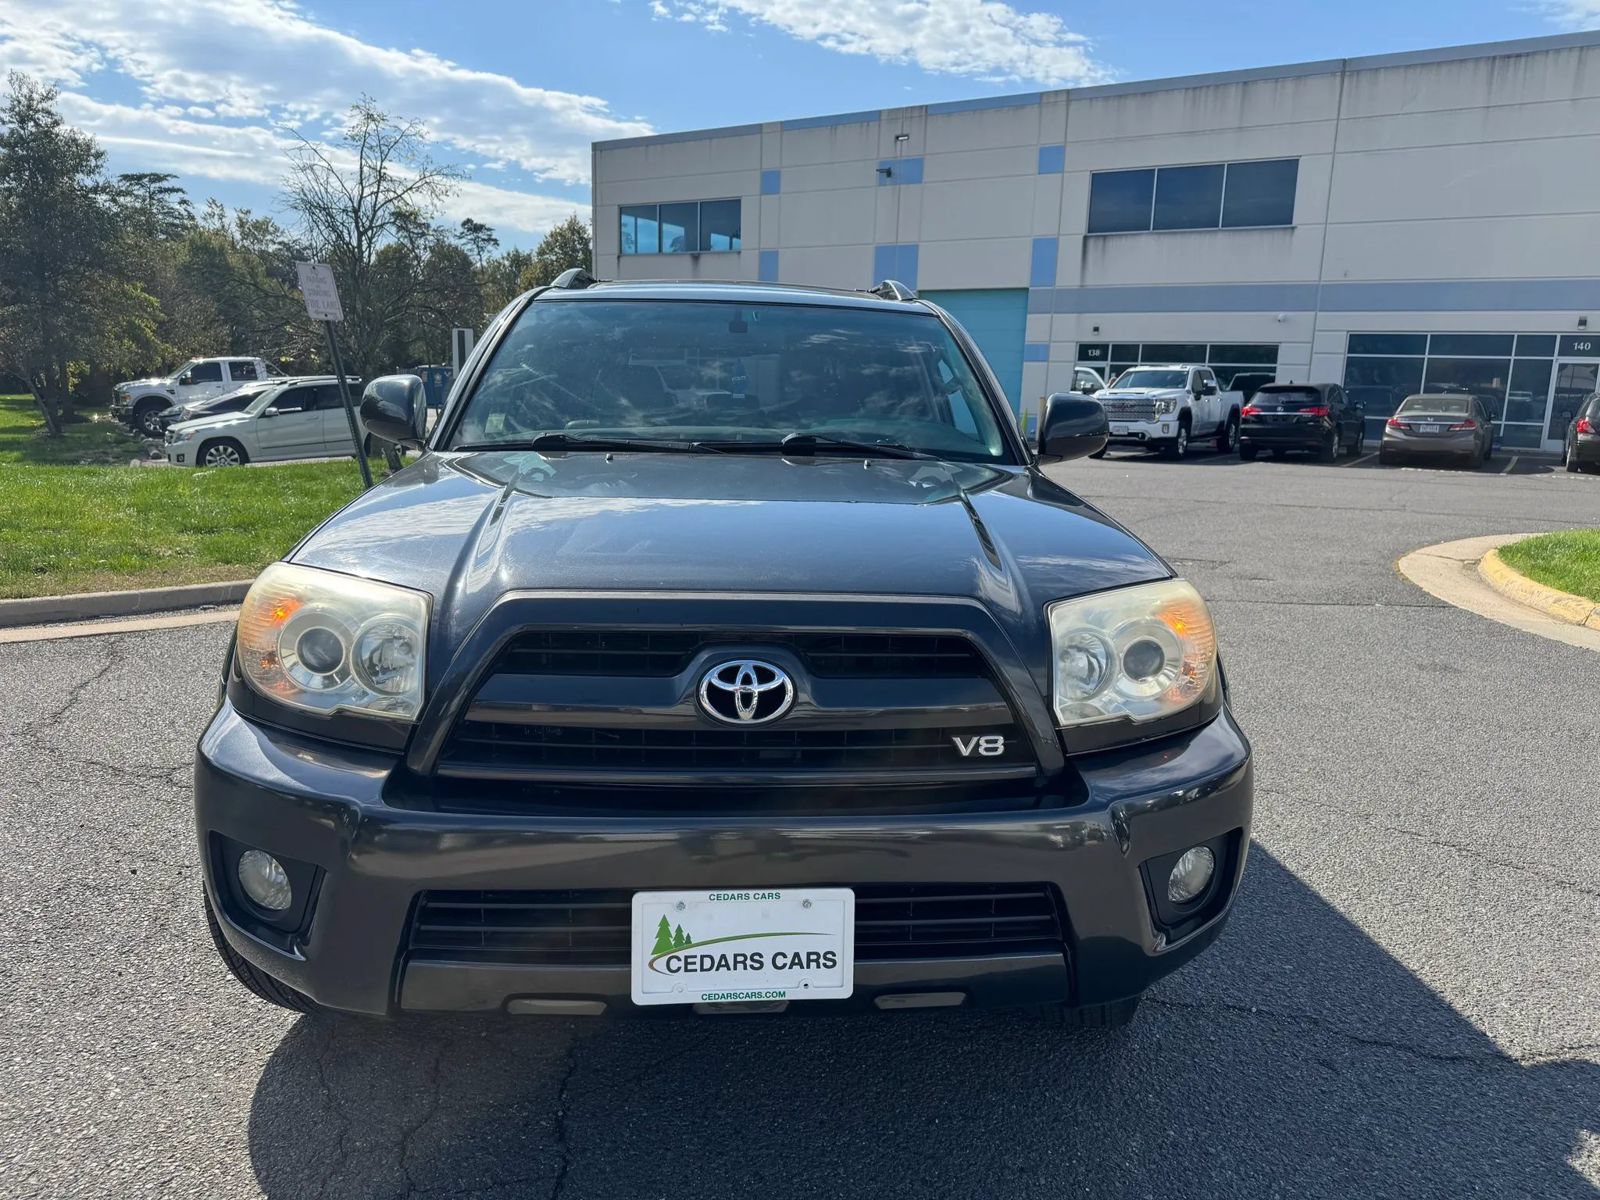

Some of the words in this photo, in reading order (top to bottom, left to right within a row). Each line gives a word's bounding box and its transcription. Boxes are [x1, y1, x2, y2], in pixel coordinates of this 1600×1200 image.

[1572, 341, 1591, 351] 140
[952, 735, 1005, 757] V8
[708, 892, 751, 901] CEDARS
[753, 892, 781, 901] CARS
[665, 952, 765, 974] CEDARS
[771, 950, 838, 970] CARS
[701, 990, 786, 1001] CEDARSCARS.COM
